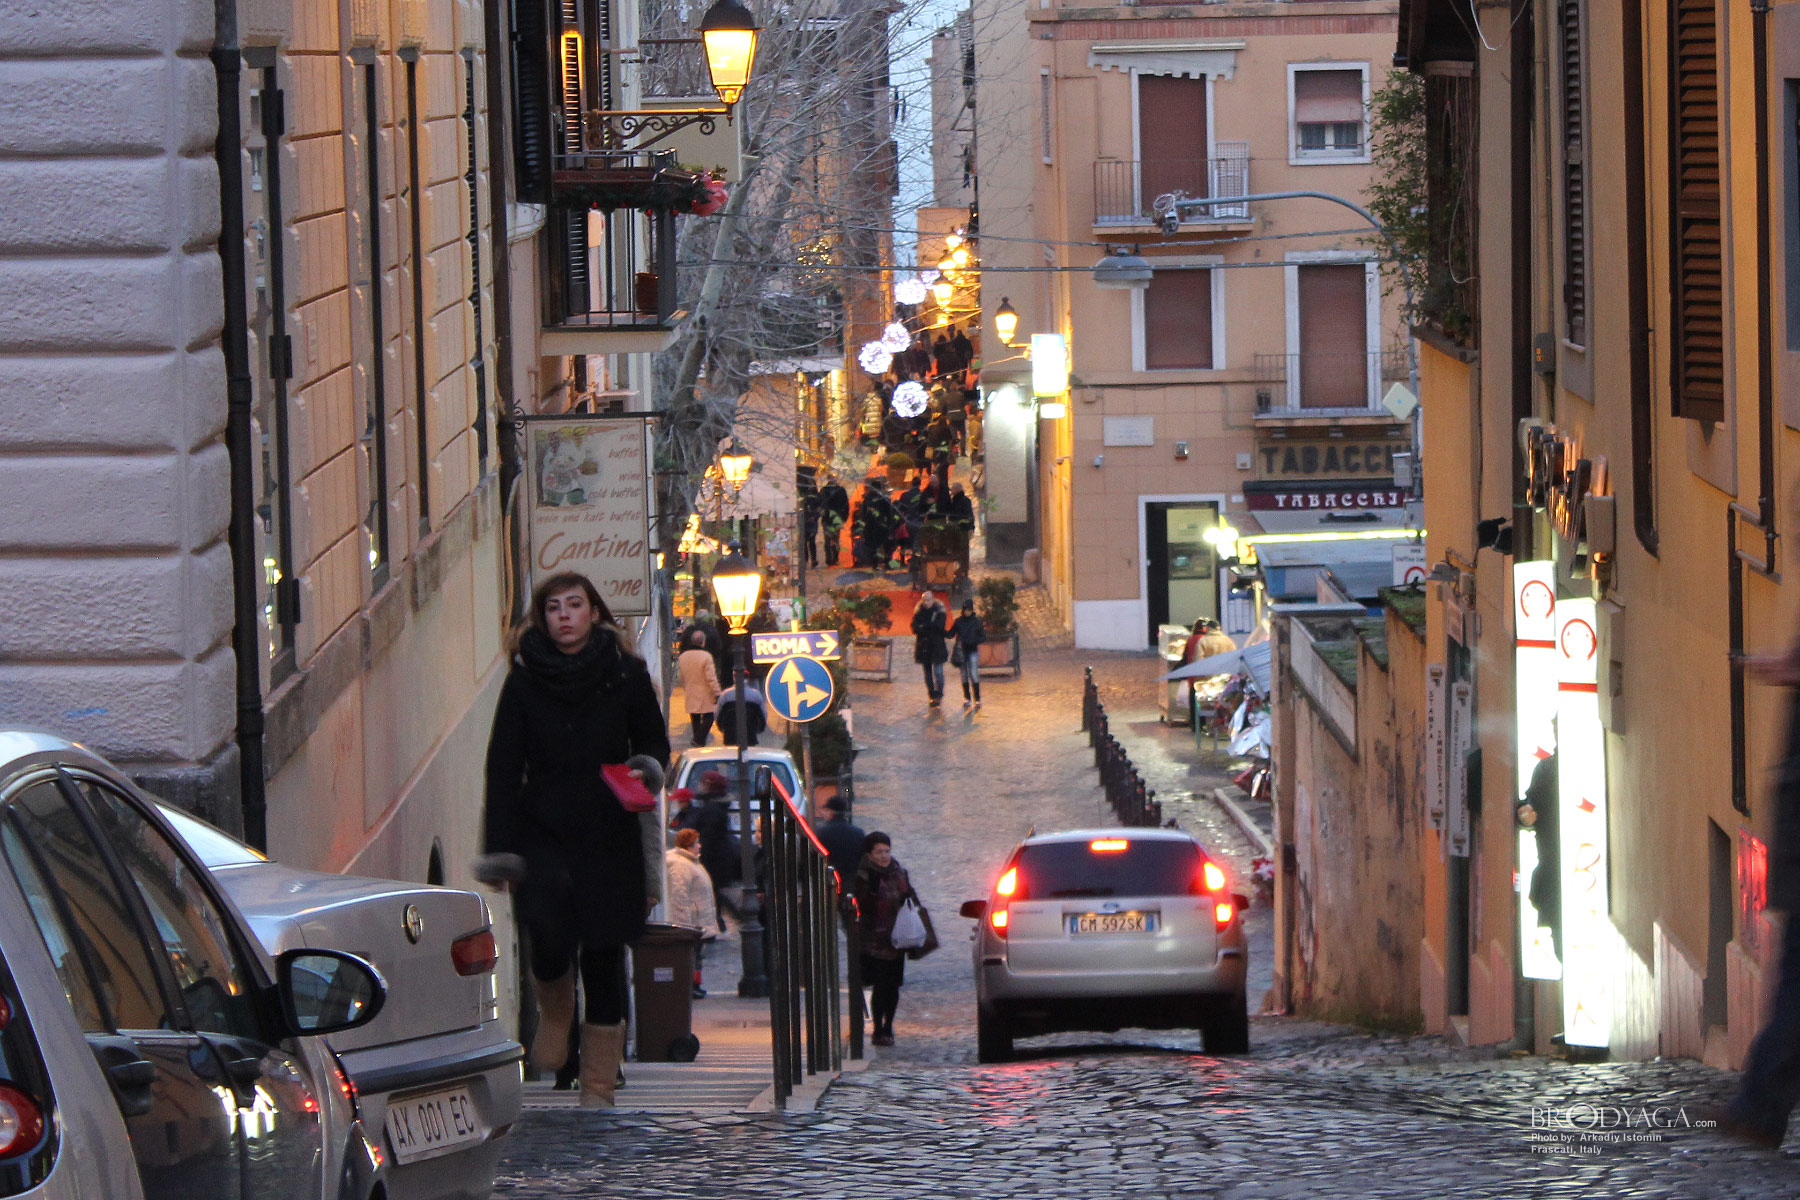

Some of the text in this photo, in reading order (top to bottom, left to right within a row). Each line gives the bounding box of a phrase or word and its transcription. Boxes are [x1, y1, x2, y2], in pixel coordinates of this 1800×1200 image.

[608, 448, 640, 459] buffet
[1260, 445, 1412, 474] TABACCH
[611, 487, 642, 499] buffet
[1275, 492, 1399, 508] TABACCHI
[610, 510, 641, 522] buffet
[538, 532, 644, 571] Cantina
[755, 637, 812, 656] ROMA
[1427, 690, 1435, 740] STAMPA
[1079, 916, 1097, 932] CM
[391, 1094, 474, 1150] AX 001 EC
